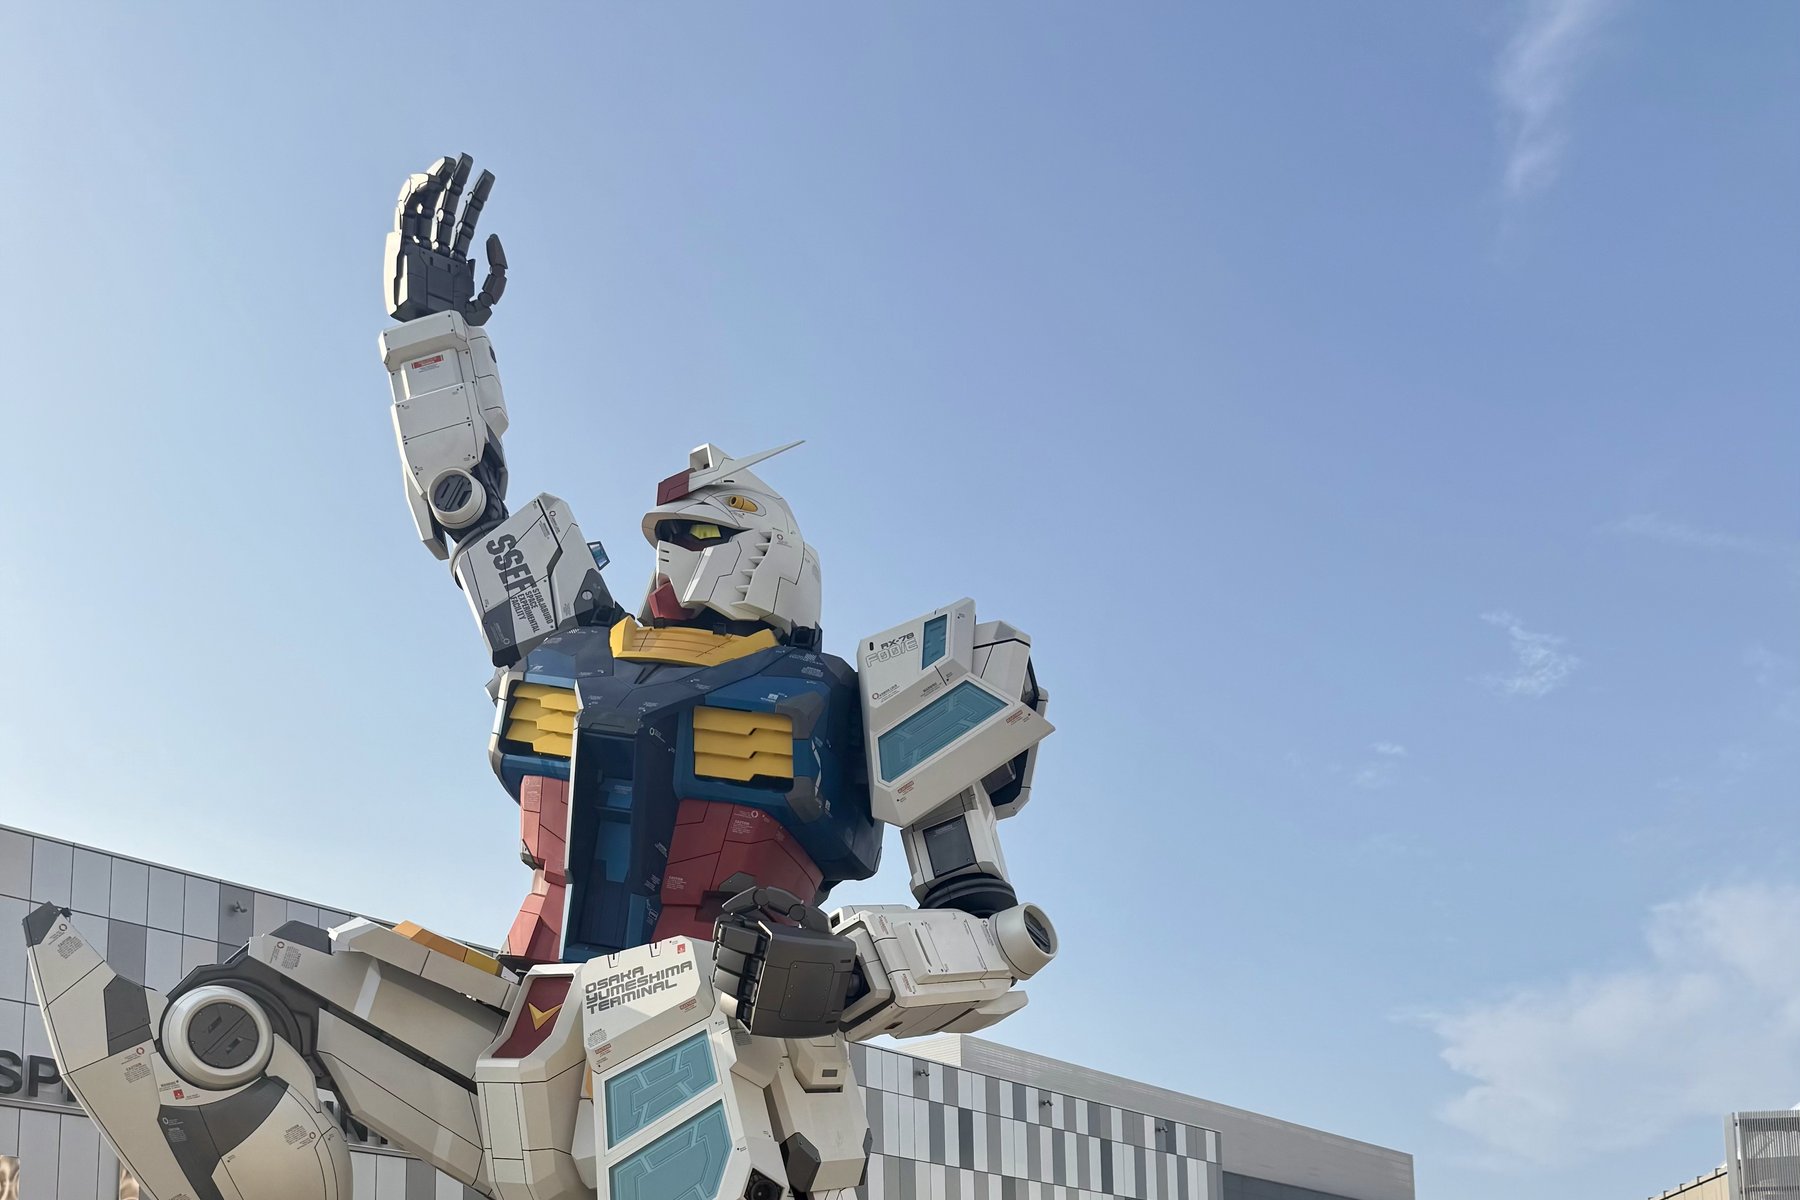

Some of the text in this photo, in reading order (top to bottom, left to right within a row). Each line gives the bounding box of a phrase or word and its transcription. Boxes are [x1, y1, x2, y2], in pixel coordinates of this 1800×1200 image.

[486, 534, 538, 592] SSEF
[511, 596, 526, 620] FACILITY
[517, 593, 540, 633] EXPERIMENTAL
[525, 590, 539, 609] SPACE
[880, 632, 914, 649] RX-78
[586, 966, 644, 994] OSAKA
[586, 960, 692, 1005] YUMESHIMA
[586, 980, 677, 1014] TERMINAL
